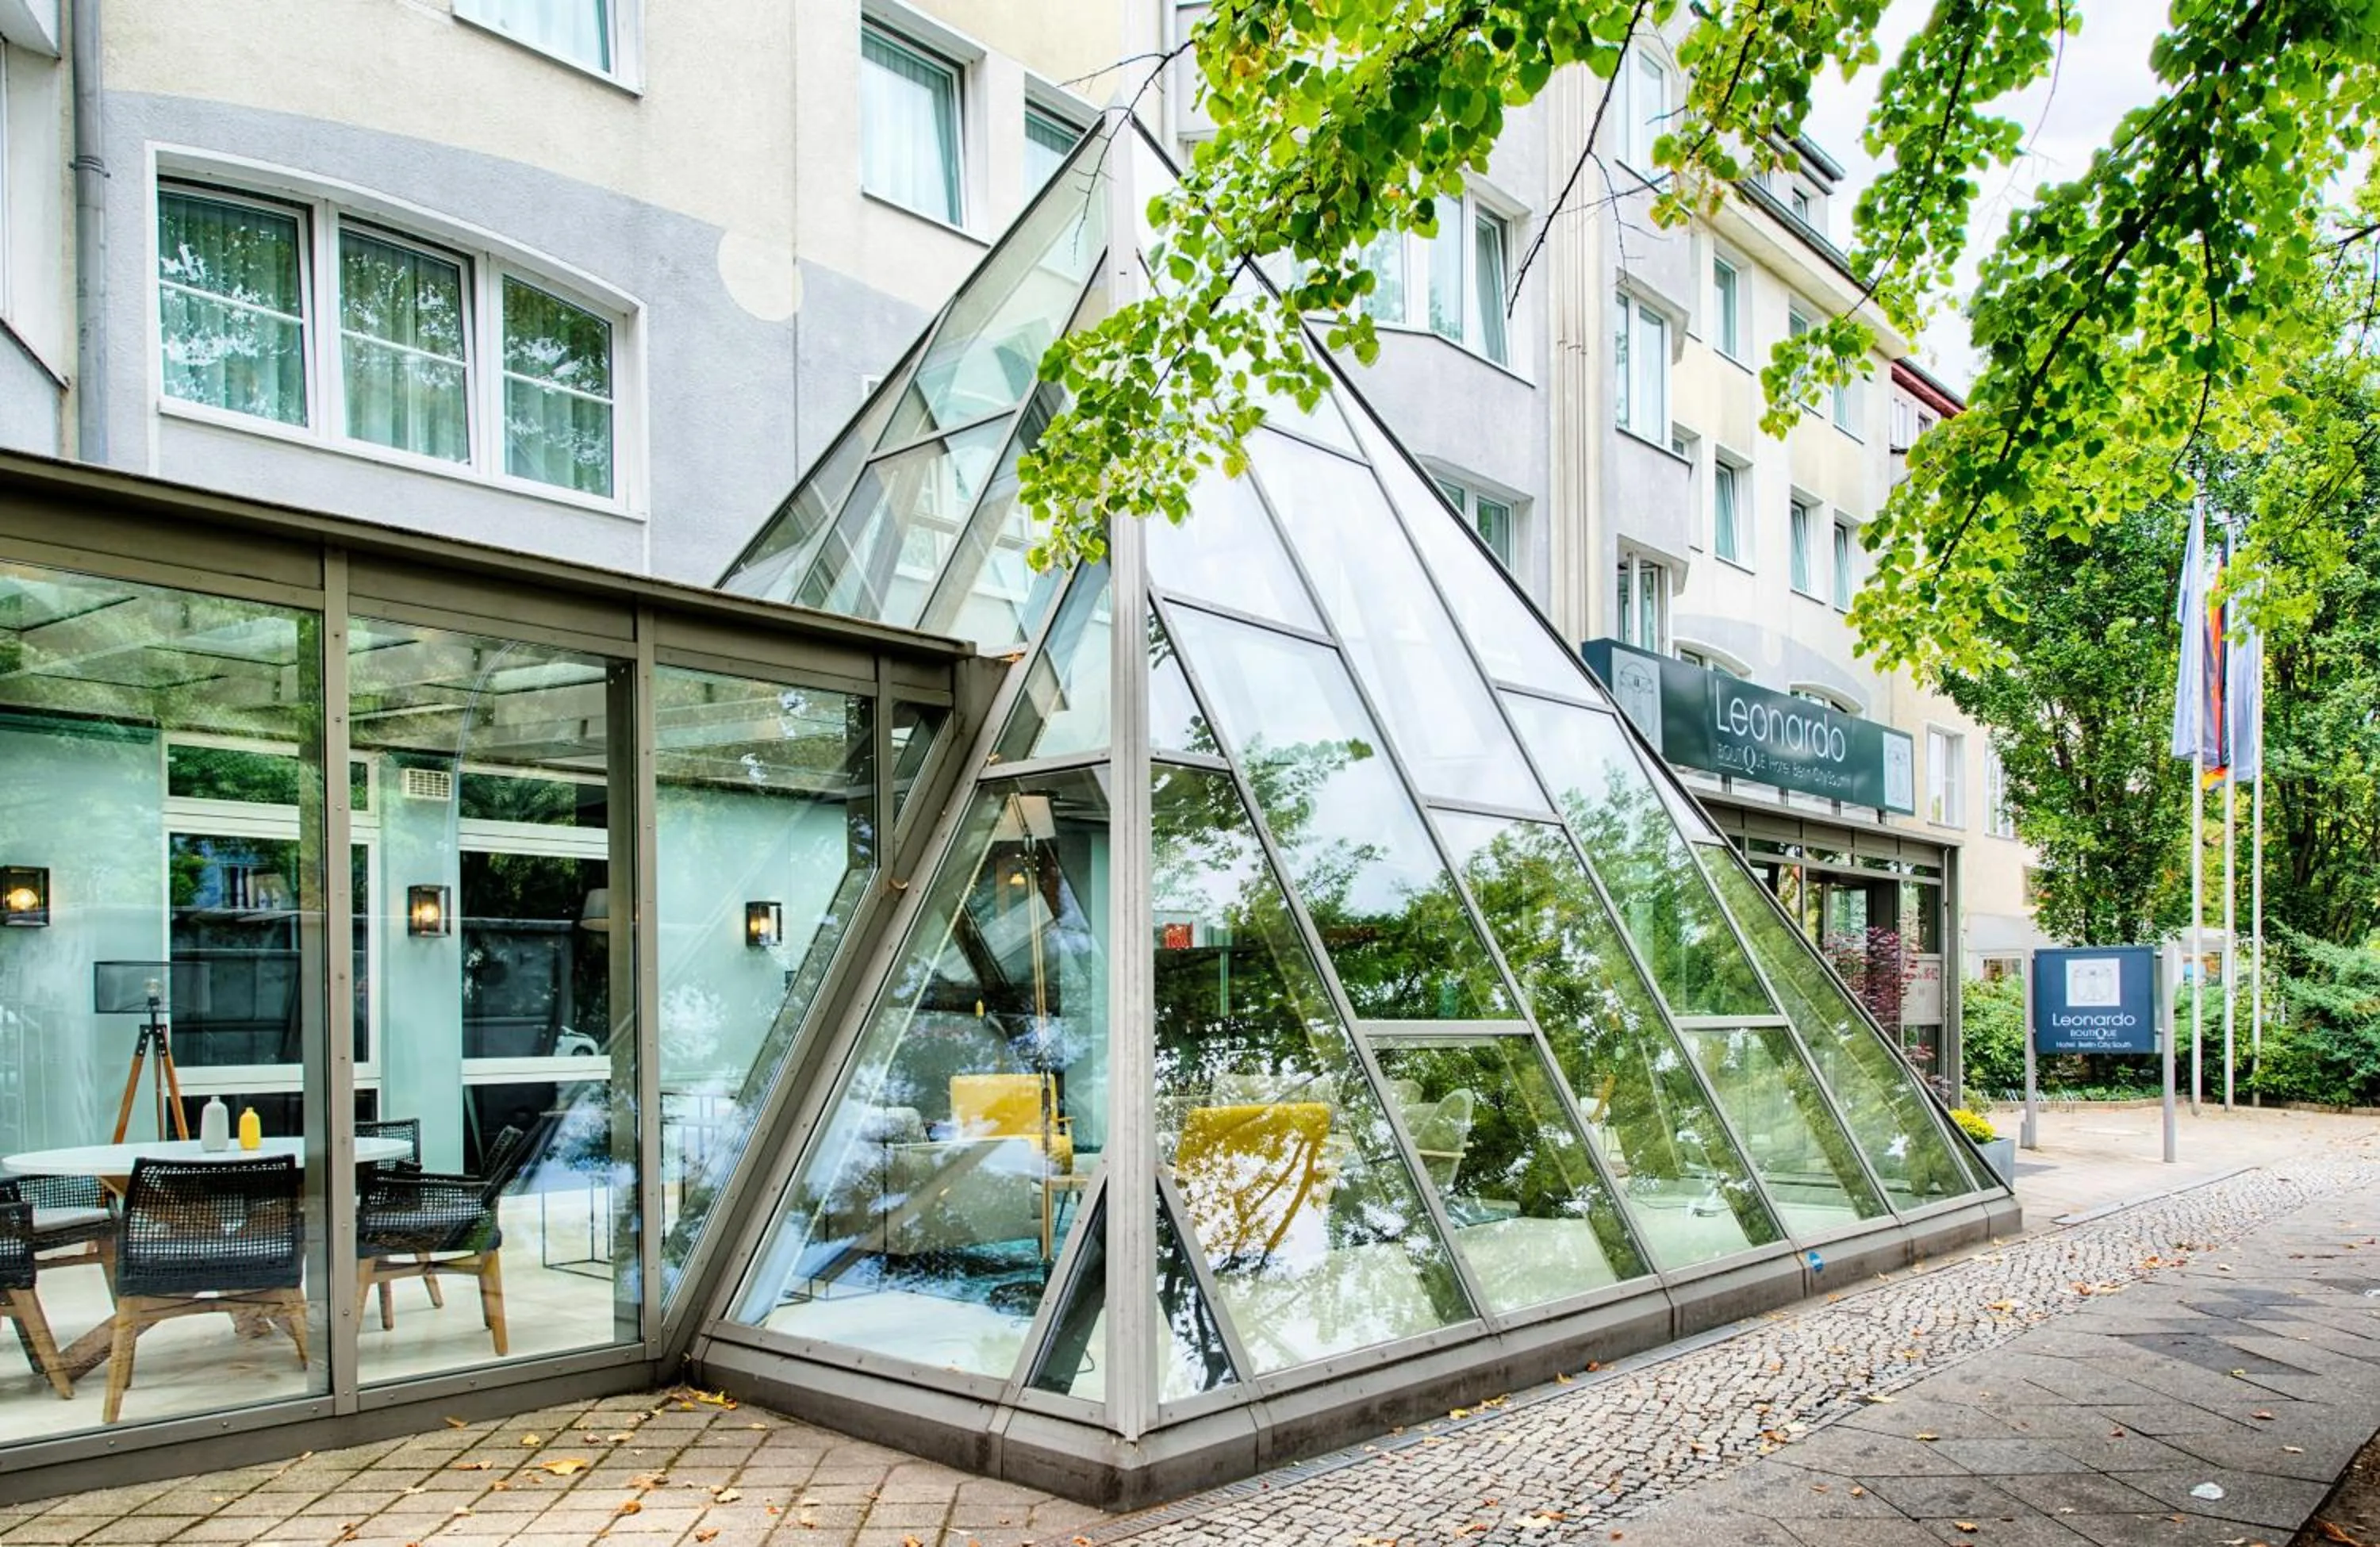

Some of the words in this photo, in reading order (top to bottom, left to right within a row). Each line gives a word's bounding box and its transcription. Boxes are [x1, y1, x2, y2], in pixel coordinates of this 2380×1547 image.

[1715, 679, 1846, 762] Leonardo
[2052, 1012, 2136, 1027] Leonardo
[2070, 1028, 2117, 1040] BOUTIQUE
